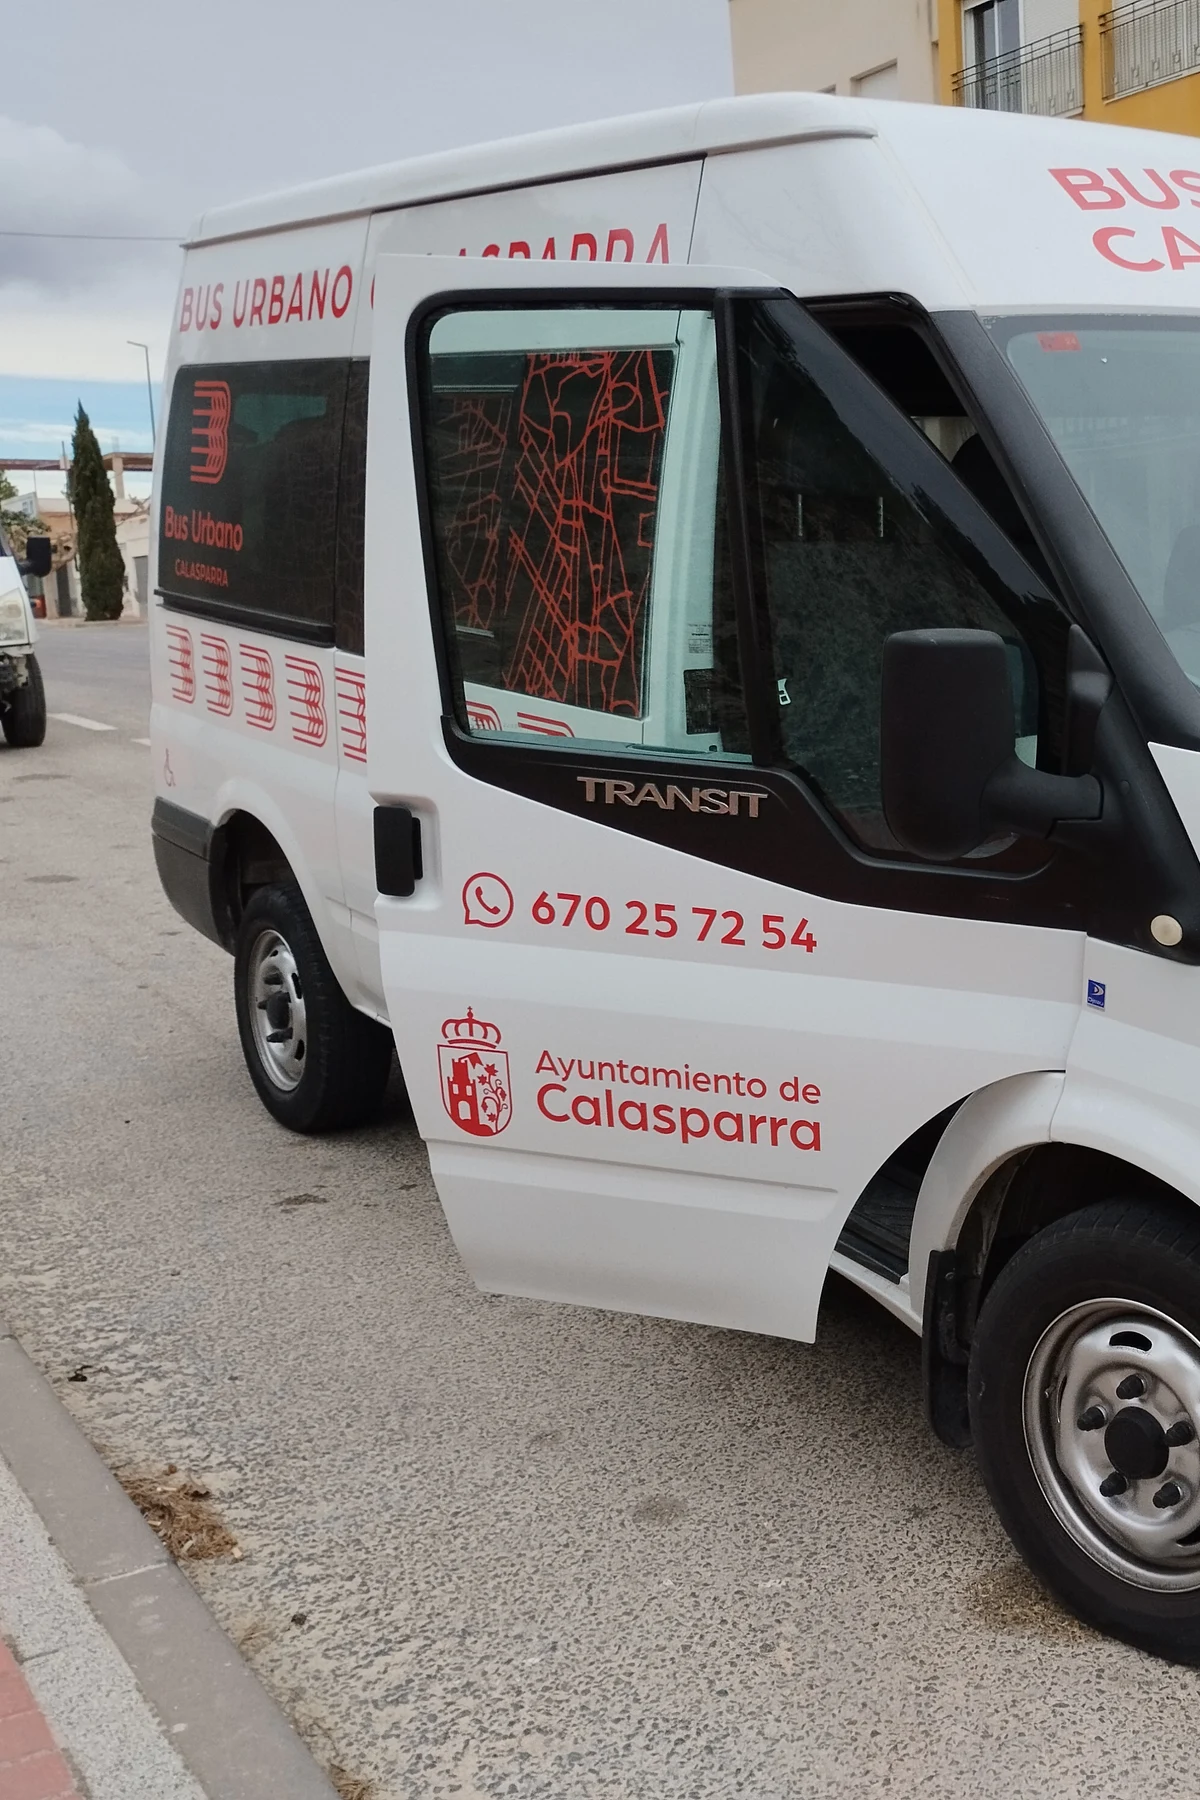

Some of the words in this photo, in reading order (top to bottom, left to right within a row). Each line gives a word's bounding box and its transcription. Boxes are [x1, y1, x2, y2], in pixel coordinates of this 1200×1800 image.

[179, 283, 225, 333] BUS
[232, 264, 353, 329] URBANO
[164, 505, 189, 541] Bus
[191, 508, 244, 552] Urbano
[174, 558, 229, 588] CALASPARRA
[576, 775, 769, 819] TRANSIT
[531, 890, 612, 931] 670
[624, 900, 679, 939] 25
[691, 906, 746, 947] 72
[761, 913, 818, 953] 54
[535, 1049, 767, 1098] Ayuntamiento
[779, 1076, 822, 1105] de
[536, 1083, 822, 1152] Calasparra
